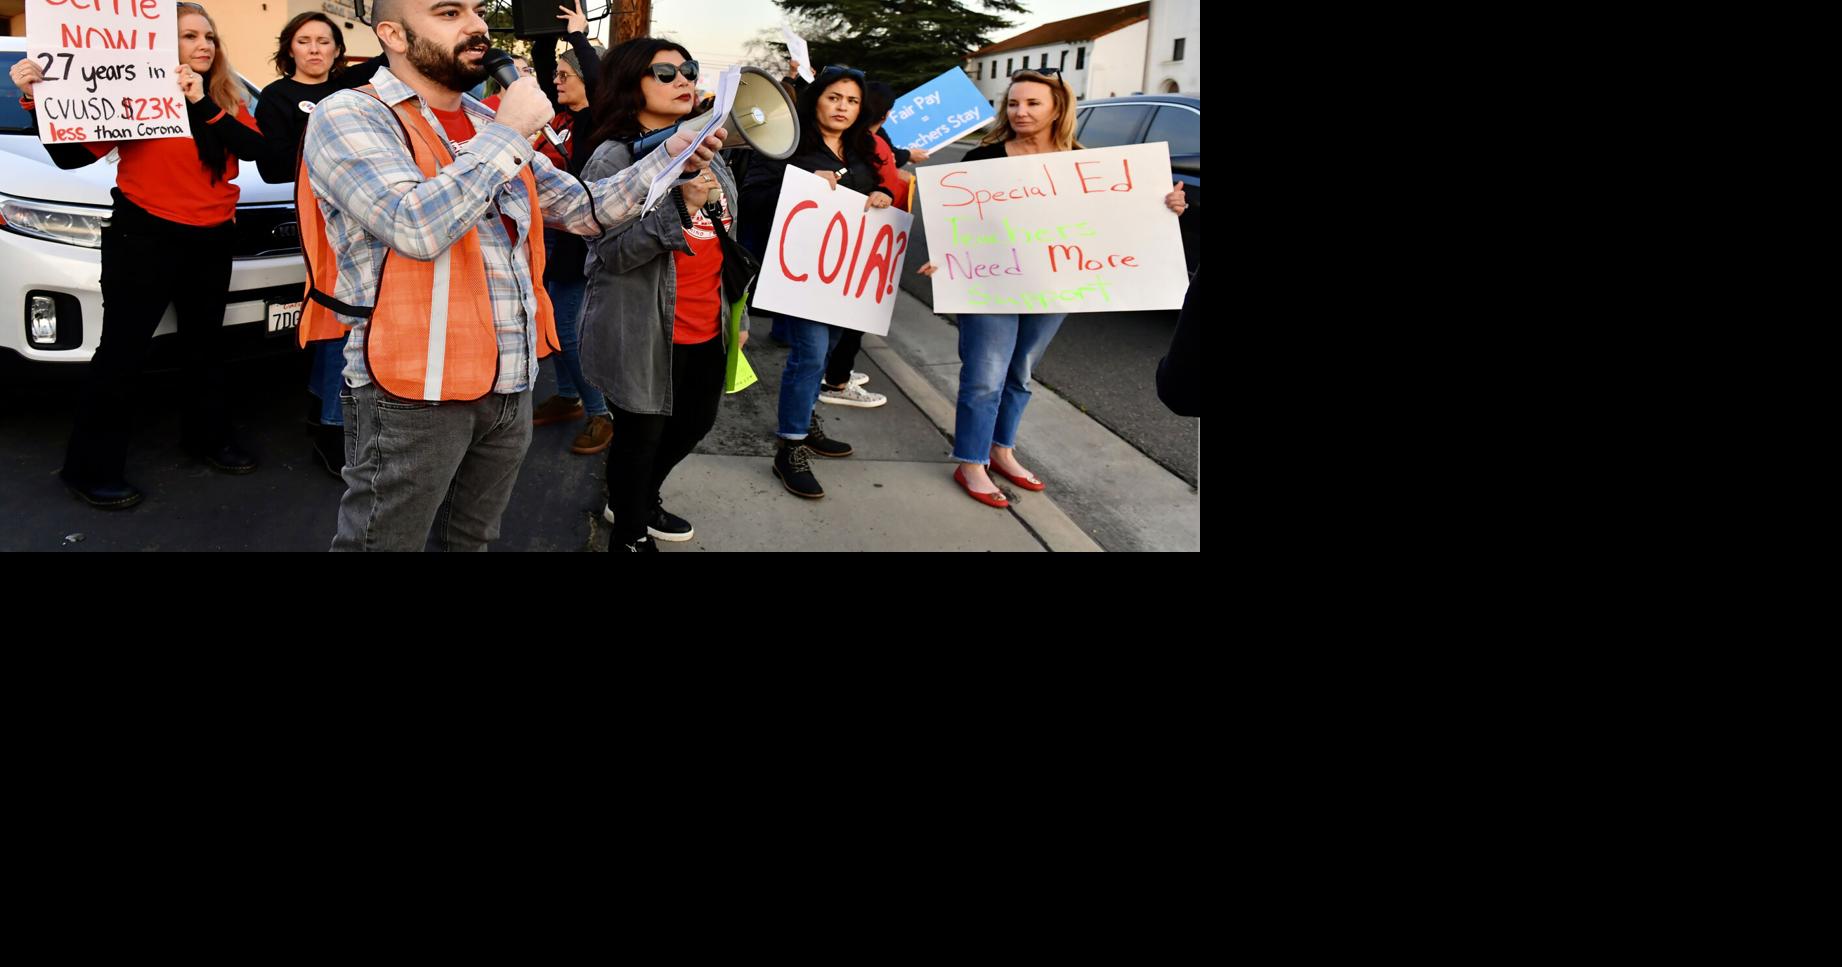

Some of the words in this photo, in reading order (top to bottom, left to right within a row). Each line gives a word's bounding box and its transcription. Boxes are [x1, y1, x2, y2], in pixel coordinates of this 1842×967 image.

[37, 52, 75, 81] 27
[81, 63, 136, 93] years
[148, 62, 165, 79] in
[888, 104, 916, 124] Fair
[913, 91, 941, 110] Pay
[49, 122, 87, 142] less
[94, 125, 132, 140] than
[137, 123, 184, 136] Corona
[895, 123, 951, 151] achers
[947, 106, 980, 128] Stay
[939, 163, 1057, 220] Special
[1074, 159, 1133, 194] Ed
[945, 248, 1024, 280] Need
[1048, 244, 1139, 273] More
[967, 275, 1114, 311] Support
